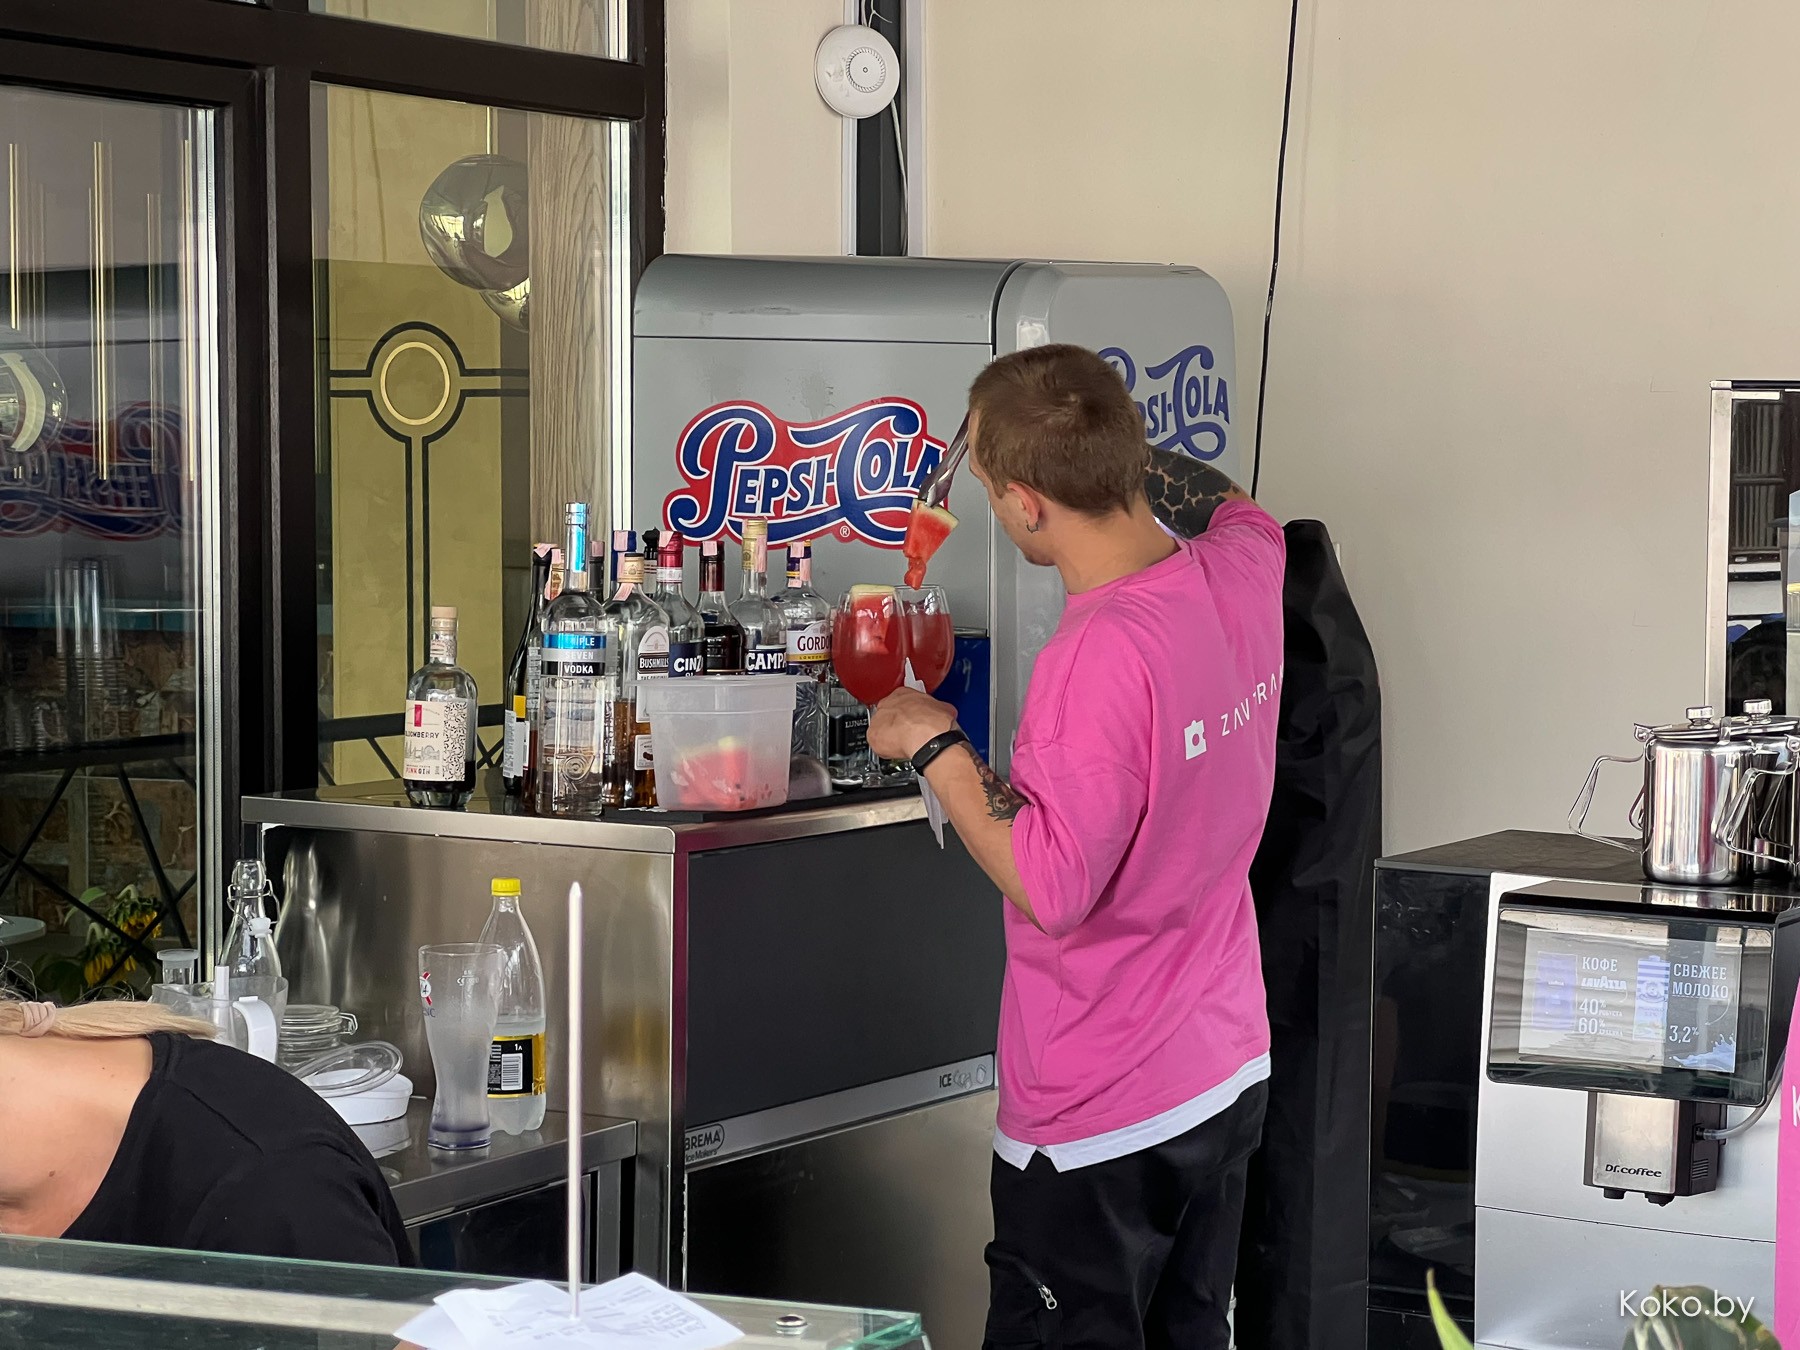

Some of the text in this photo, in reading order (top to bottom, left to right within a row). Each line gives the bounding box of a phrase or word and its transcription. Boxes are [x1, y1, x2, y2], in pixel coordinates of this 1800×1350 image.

[565, 651, 594, 660] SEVEN
[564, 664, 594, 674] VODKA
[1582, 956, 1618, 972] КОФЕ
[1673, 963, 1727, 980] СВЕЖЕЕ
[1581, 975, 1627, 990] LAVAZZA
[1672, 981, 1729, 998] МОЛОКО
[1669, 1025, 1699, 1043] 3,2%
[939, 1073, 952, 1088] ICE
[685, 1130, 721, 1151] BREMA
